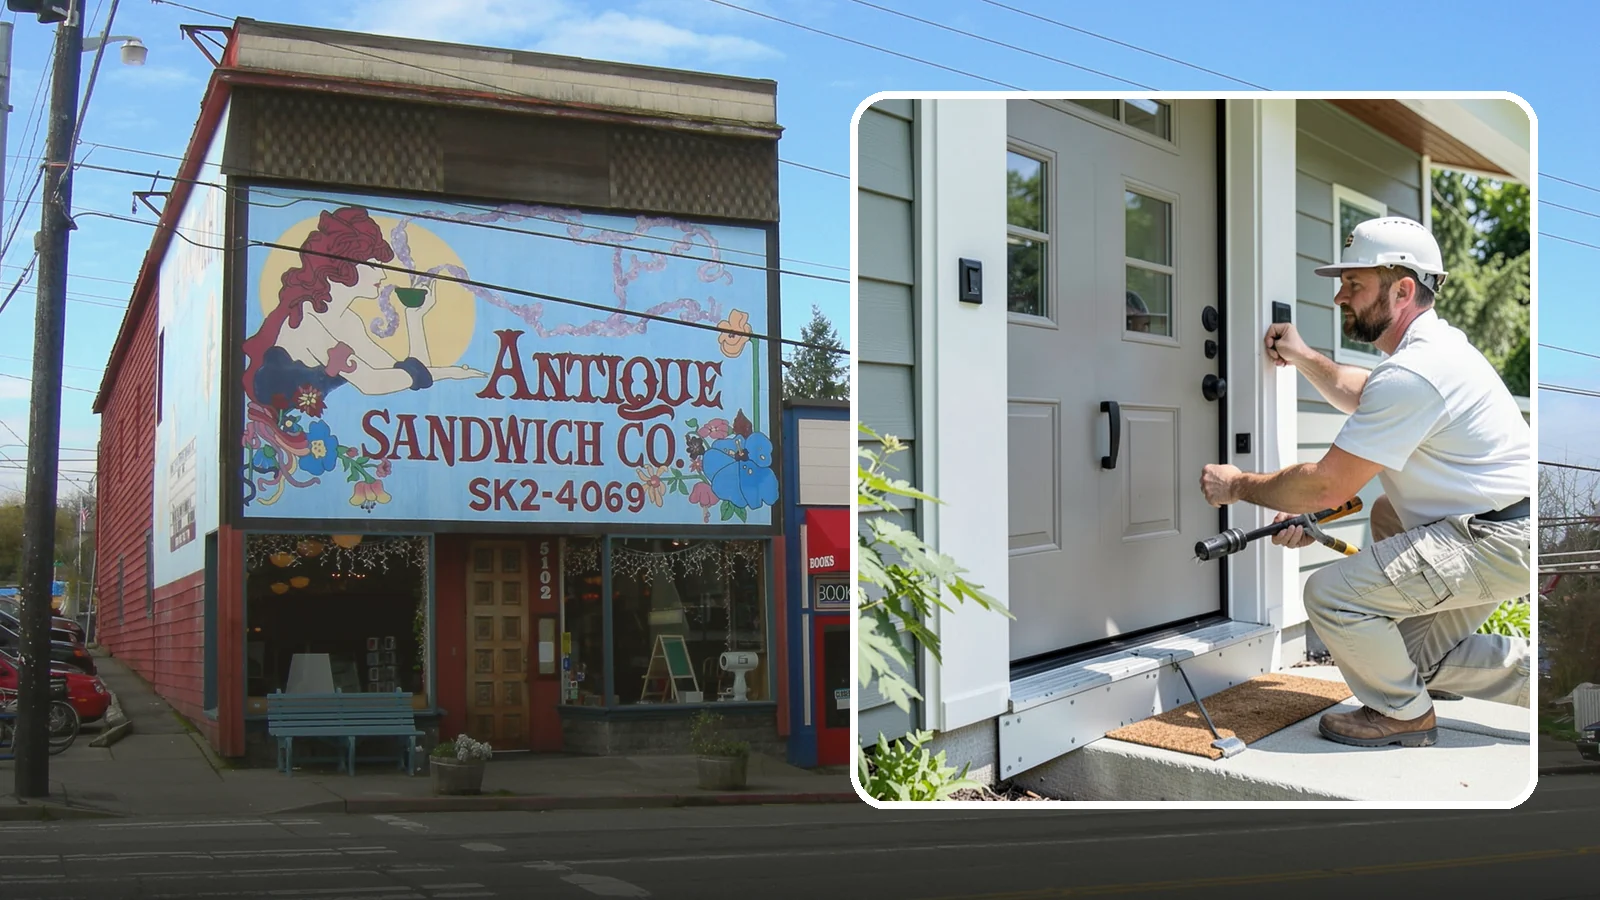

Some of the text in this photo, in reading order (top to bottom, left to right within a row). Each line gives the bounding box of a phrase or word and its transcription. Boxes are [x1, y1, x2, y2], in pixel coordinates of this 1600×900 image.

[476, 330, 723, 420] ANTIQUE
[361, 408, 685, 469] SANDWICH CO.
[468, 477, 646, 513] SK2-4069
[540, 541, 552, 600] 5102
[809, 555, 835, 569] BOOKS
